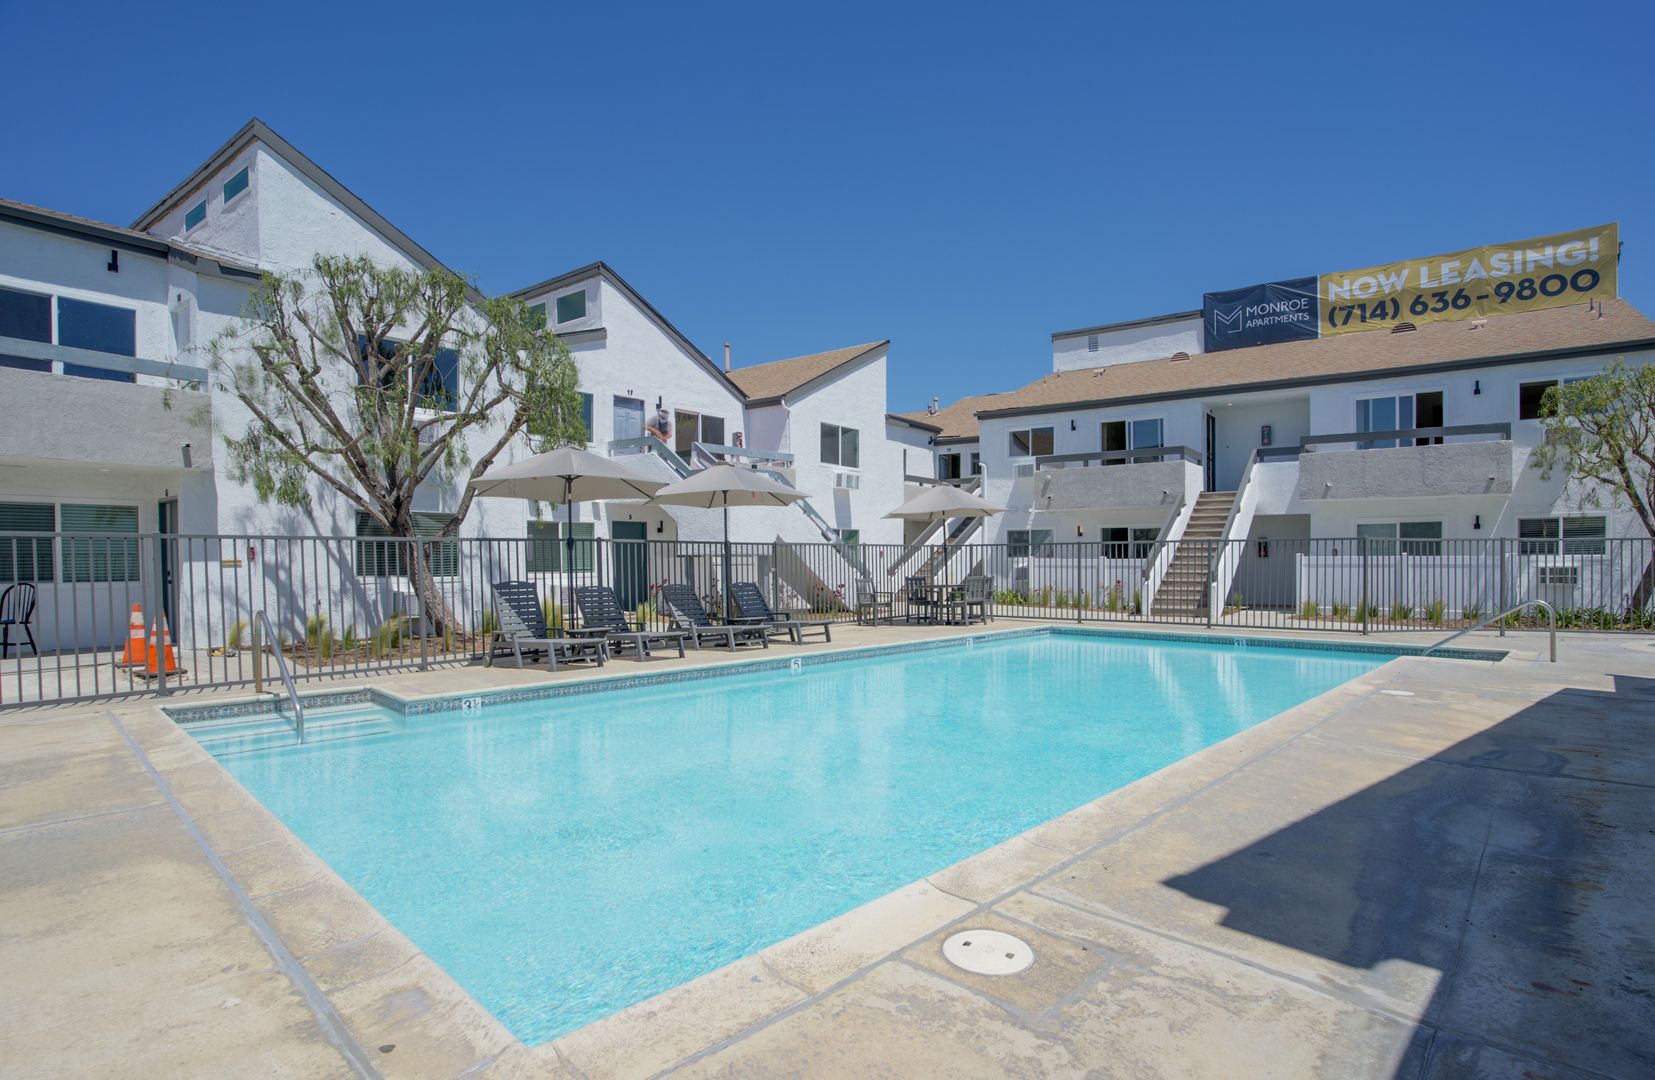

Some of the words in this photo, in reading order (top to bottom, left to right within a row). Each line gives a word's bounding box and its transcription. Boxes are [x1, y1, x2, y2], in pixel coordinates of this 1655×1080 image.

[1328, 268, 1410, 303] NOW
[1420, 237, 1600, 289] LEASING!
[1246, 298, 1310, 318] MONROE
[1328, 297, 1400, 328] (714)
[1410, 268, 1600, 316] 636-9800
[1246, 312, 1310, 329] APARTMENTS
